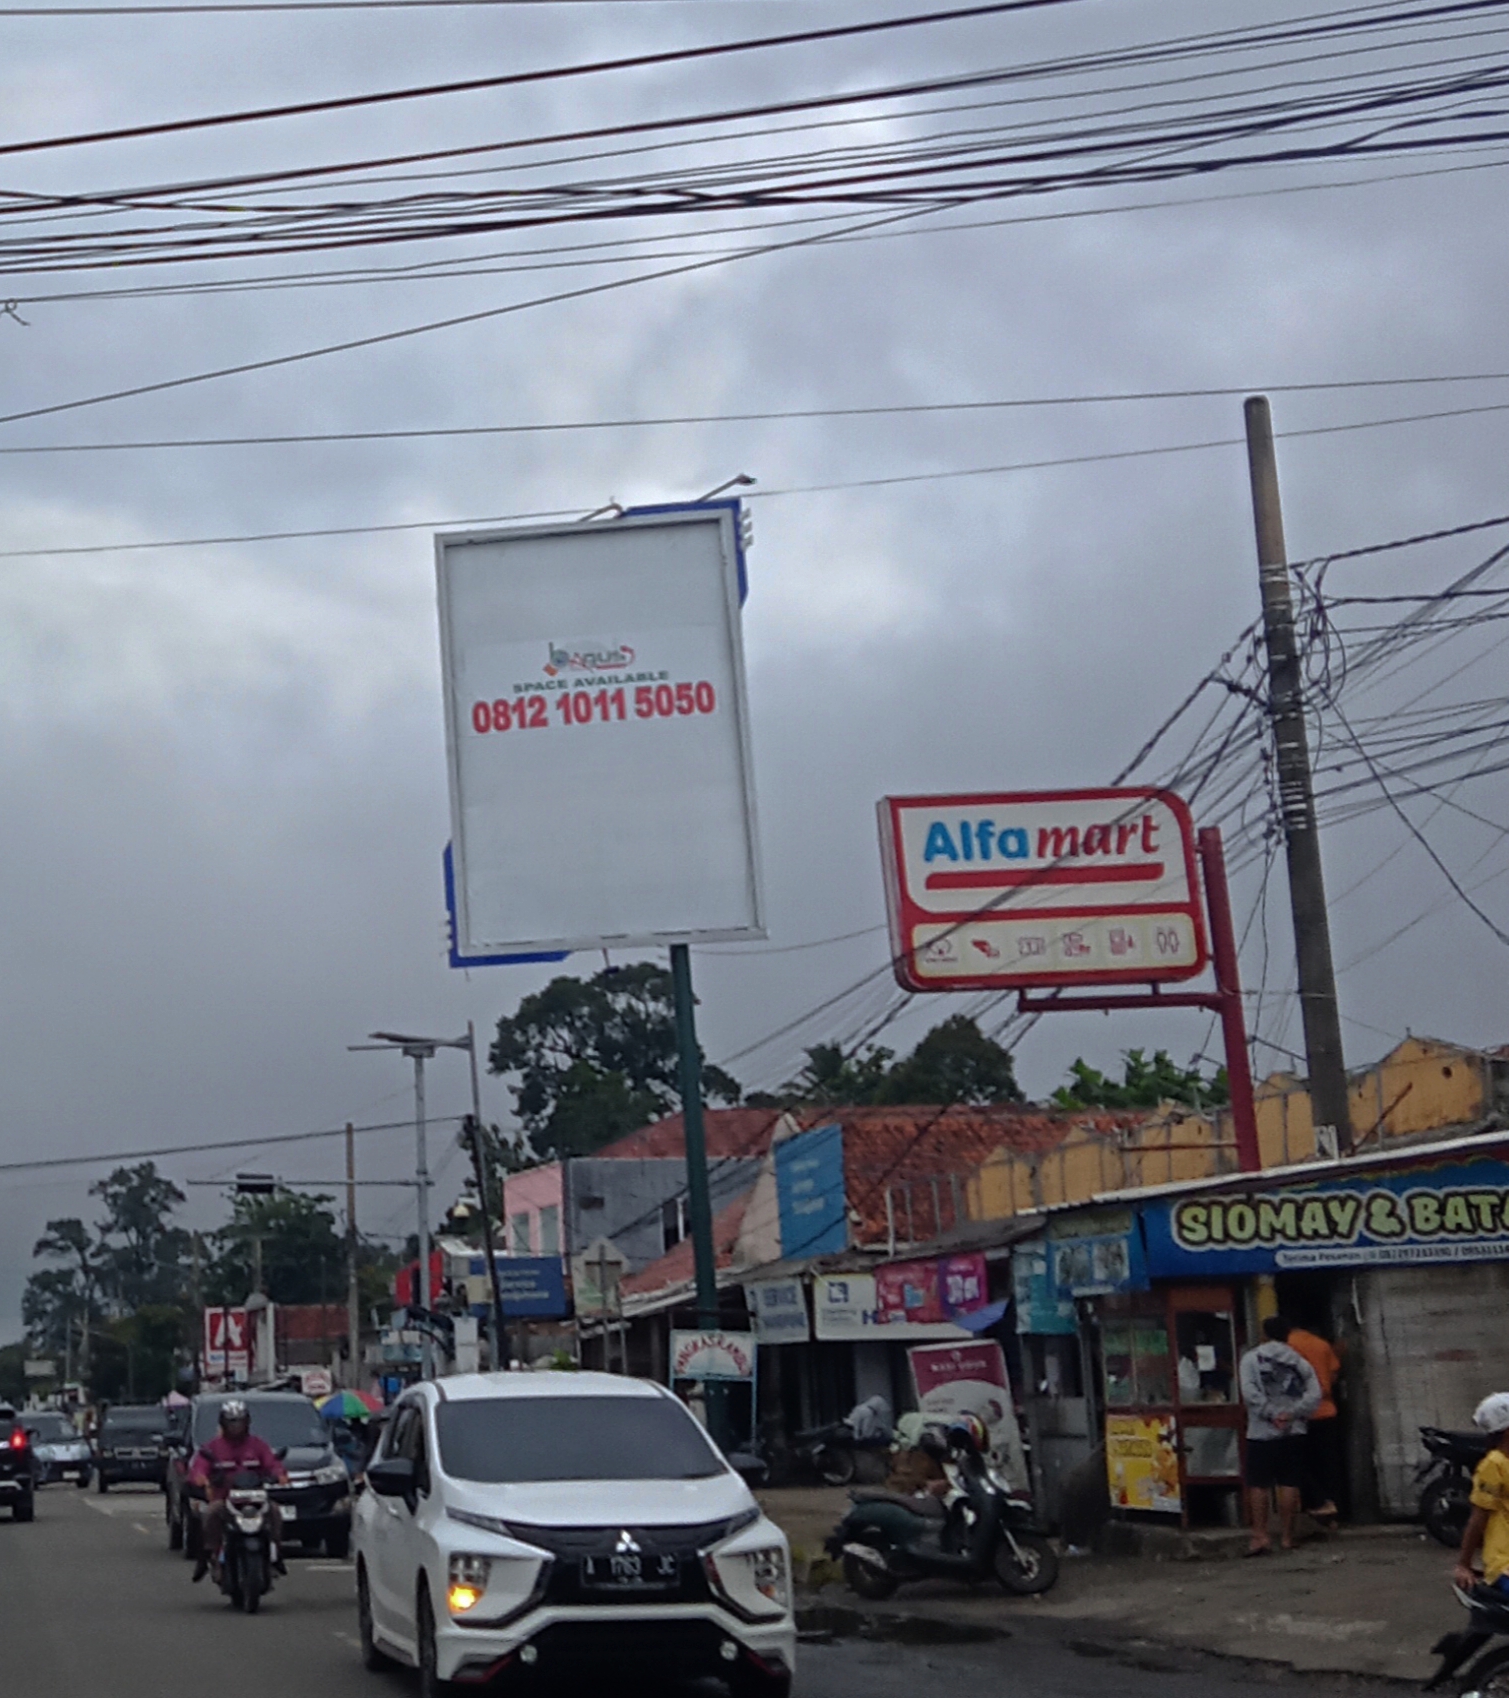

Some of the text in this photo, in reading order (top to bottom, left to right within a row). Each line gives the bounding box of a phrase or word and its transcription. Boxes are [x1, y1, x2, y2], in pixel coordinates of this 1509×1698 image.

[472, 680, 716, 733] 0812 1011 5050
[513, 671, 669, 693] SPACE AVAILABLE
[1177, 1197, 1359, 1244] SIOMAY
[1366, 1193, 1405, 1238] &
